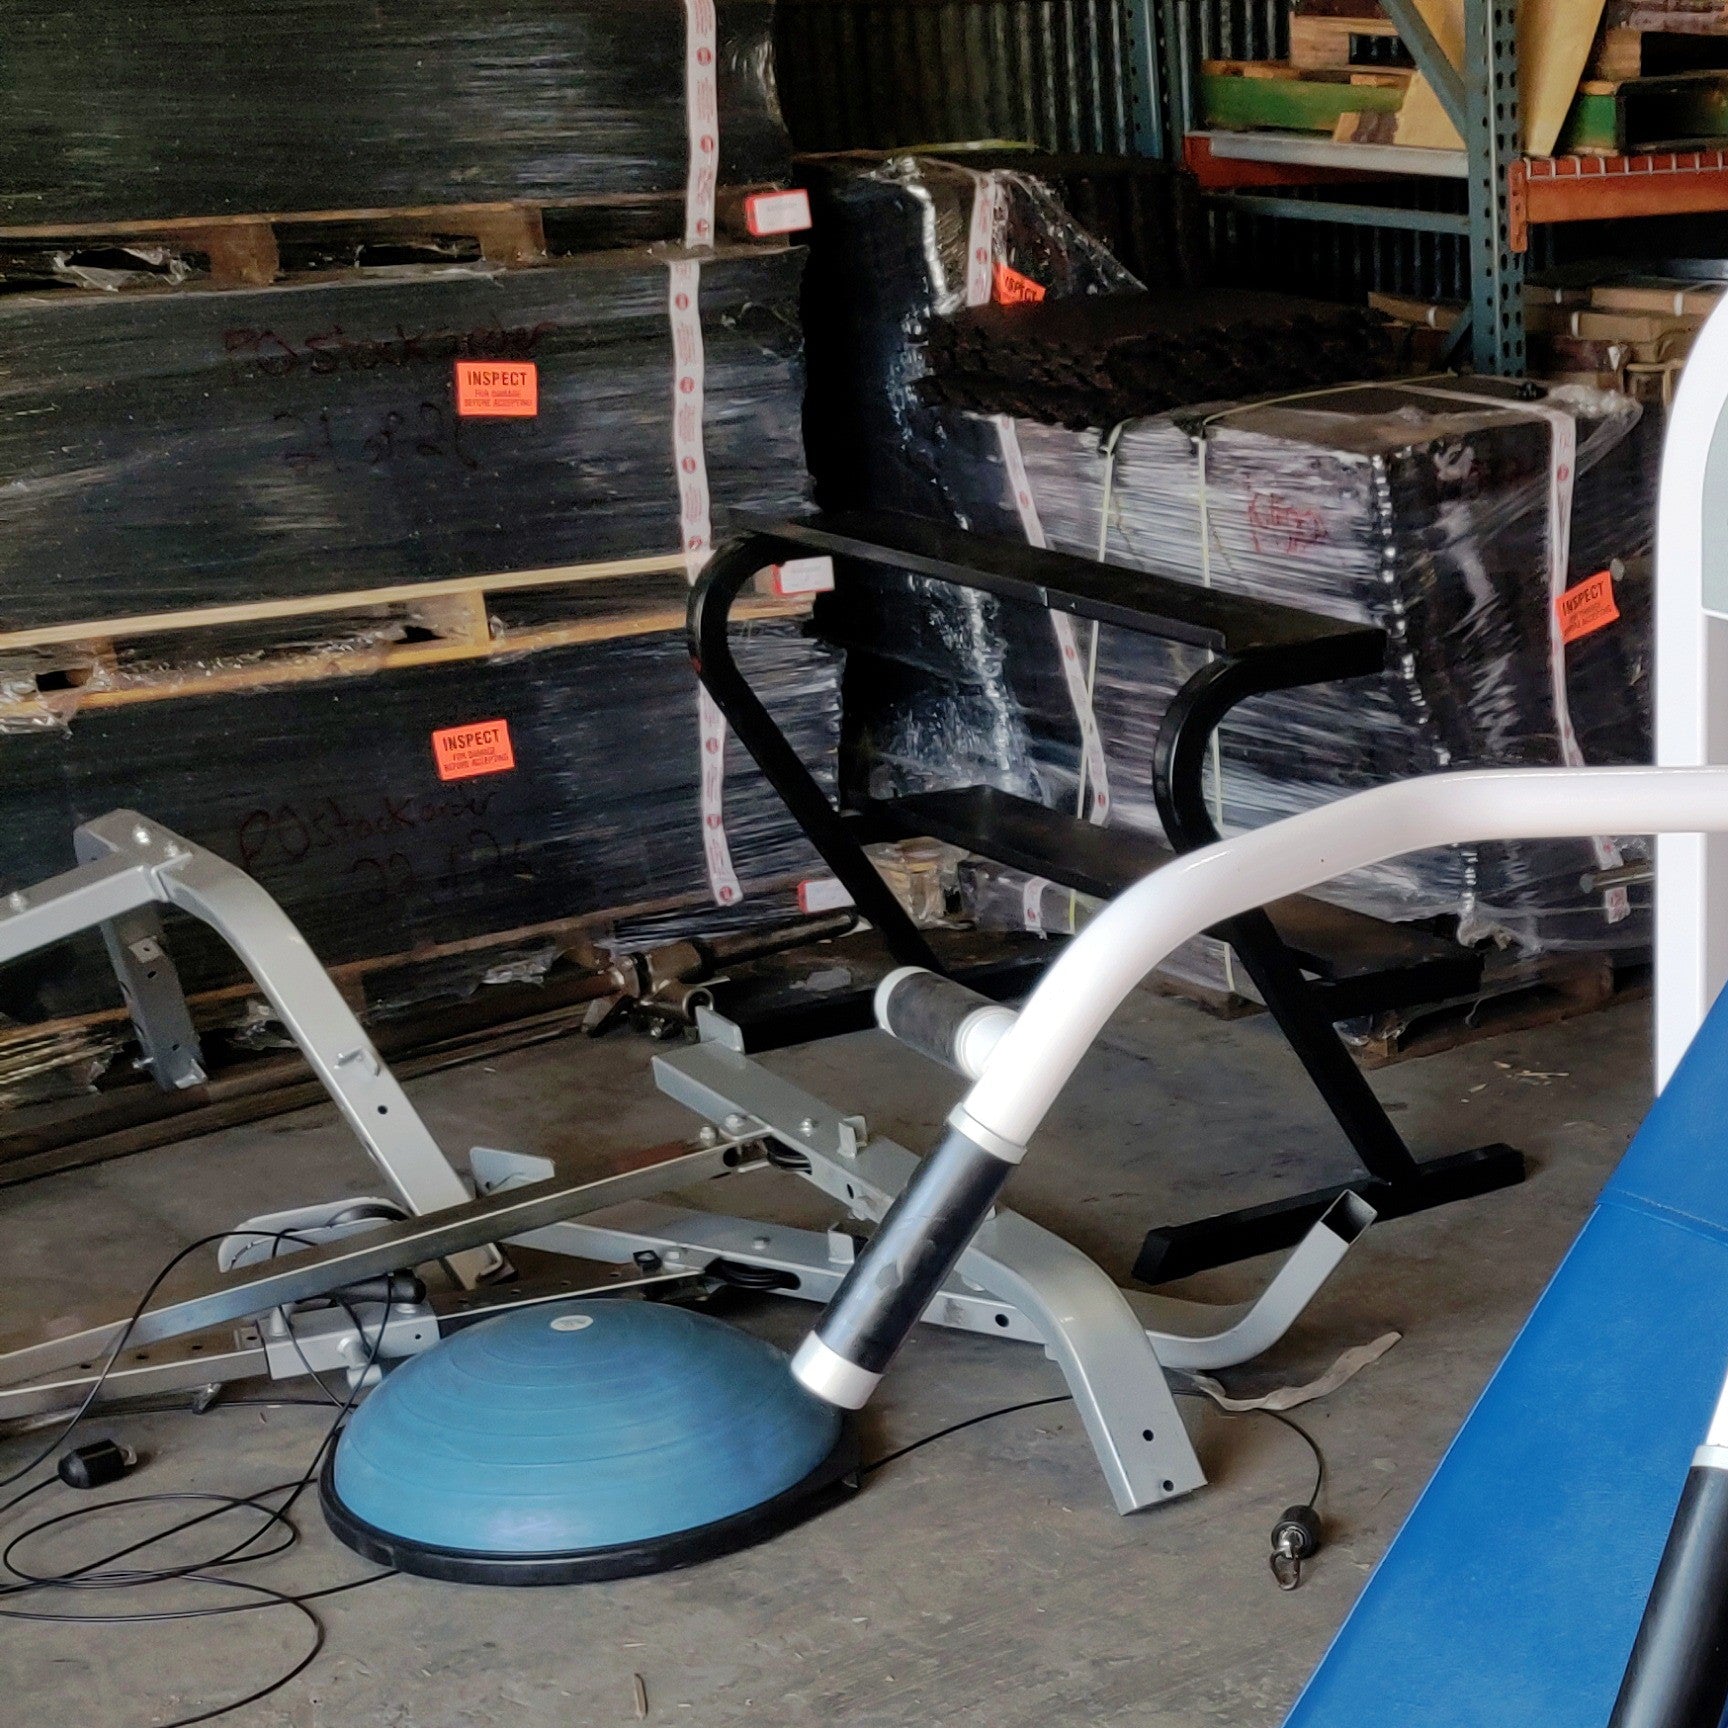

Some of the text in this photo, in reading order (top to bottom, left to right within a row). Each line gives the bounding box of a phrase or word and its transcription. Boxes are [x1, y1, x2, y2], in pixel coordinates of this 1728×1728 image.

[467, 371, 527, 386] INSPECT
[1562, 580, 1604, 617] INSPECT
[443, 729, 499, 751] INSPECT
